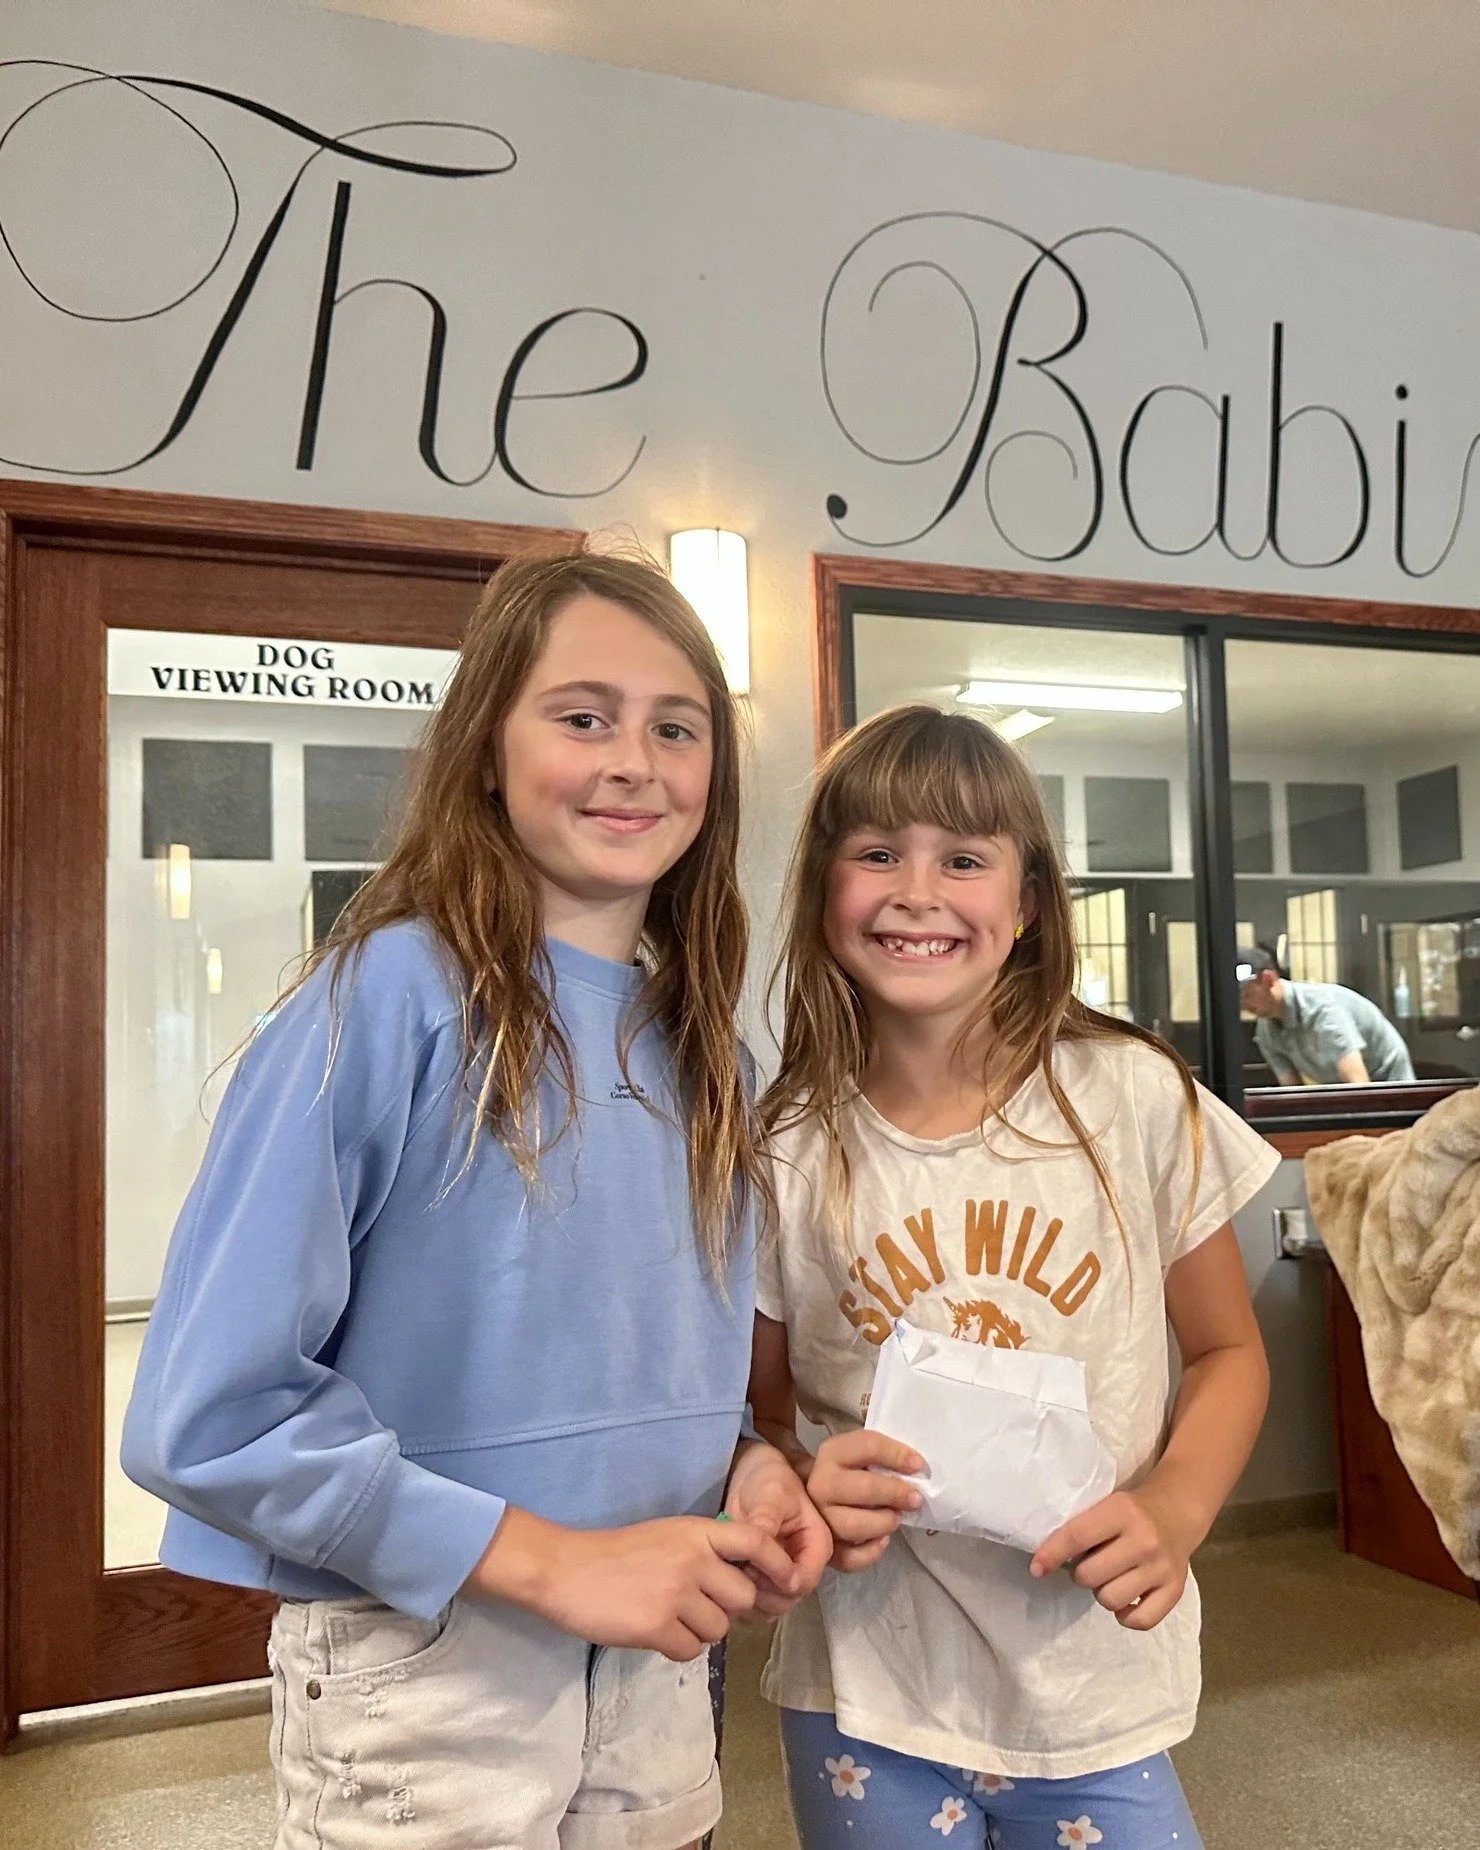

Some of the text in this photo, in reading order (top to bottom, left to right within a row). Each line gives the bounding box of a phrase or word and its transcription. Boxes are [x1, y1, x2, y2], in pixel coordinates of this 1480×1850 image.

[0, 60, 1480, 578] The Babi
[149, 666, 436, 705] VIEWING ROOM
[256, 643, 335, 671] DOG
[838, 1198, 1102, 1346] STAY WILD
